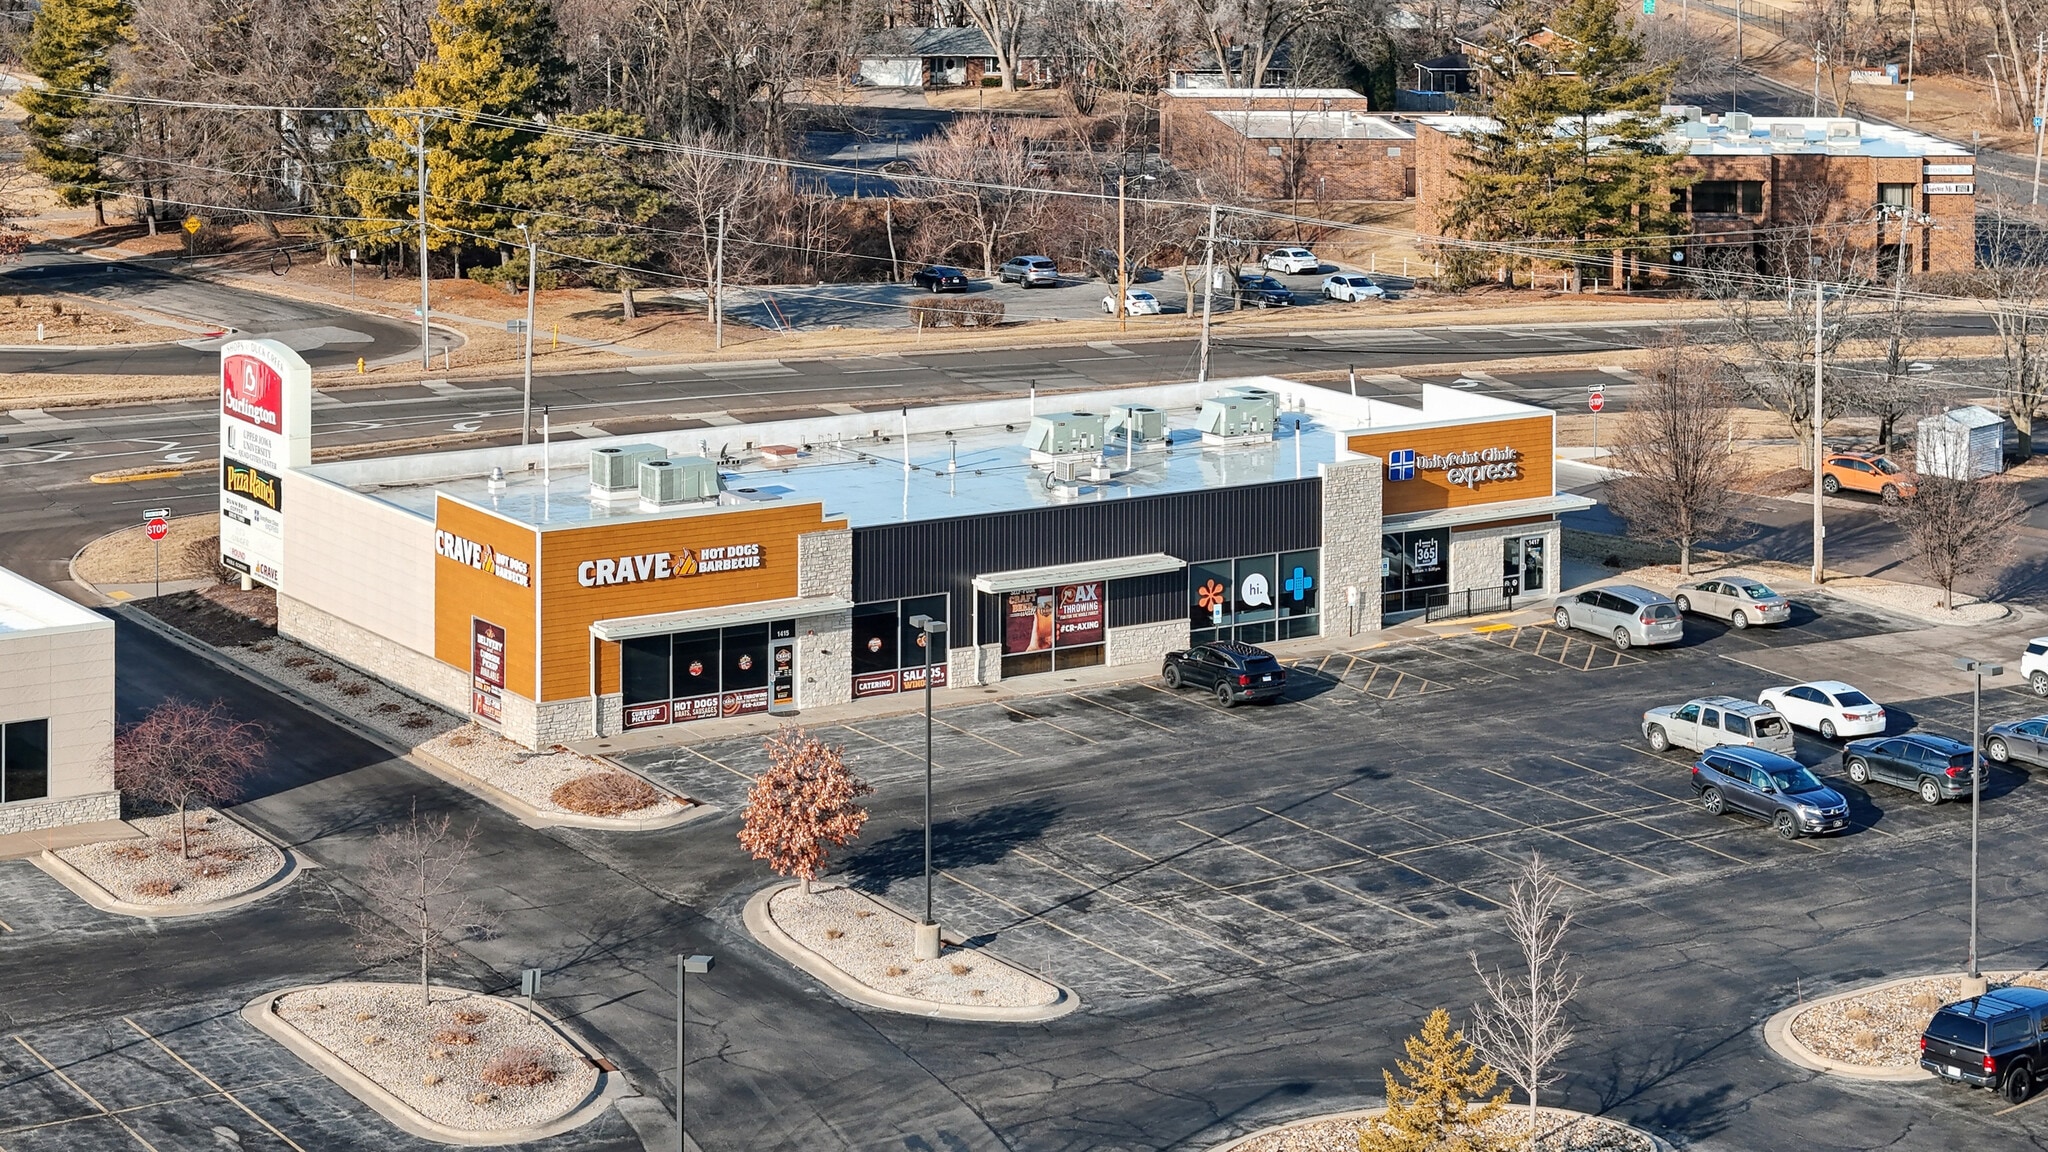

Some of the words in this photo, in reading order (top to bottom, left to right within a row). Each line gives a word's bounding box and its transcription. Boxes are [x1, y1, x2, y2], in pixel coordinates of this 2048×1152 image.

[226, 388, 276, 425] Burlington
[1416, 450, 1480, 470] UnityPoint
[1482, 446, 1517, 462] Clinic
[1447, 462, 1518, 489] express
[228, 466, 248, 492] Pizza
[248, 468, 276, 509] Ranch
[148, 524, 167, 534] STOP
[436, 529, 483, 570] CRAVE
[700, 547, 725, 561] HOT
[728, 544, 759, 558] DOGS
[1418, 546, 1435, 560] 365
[260, 563, 278, 580] CRAVE
[578, 552, 671, 588] CRAVE
[699, 556, 761, 573] BARBECUE
[1074, 584, 1098, 602] AX
[1250, 583, 1262, 596] hi.
[1063, 600, 1098, 614] THROWING
[1060, 620, 1099, 633] #CR-AXING
[859, 680, 891, 690] CATERING
[631, 708, 660, 718] CURBSIDE
[674, 701, 692, 712] HOT
[694, 698, 718, 709] DOGS
[631, 715, 646, 723] PICK
